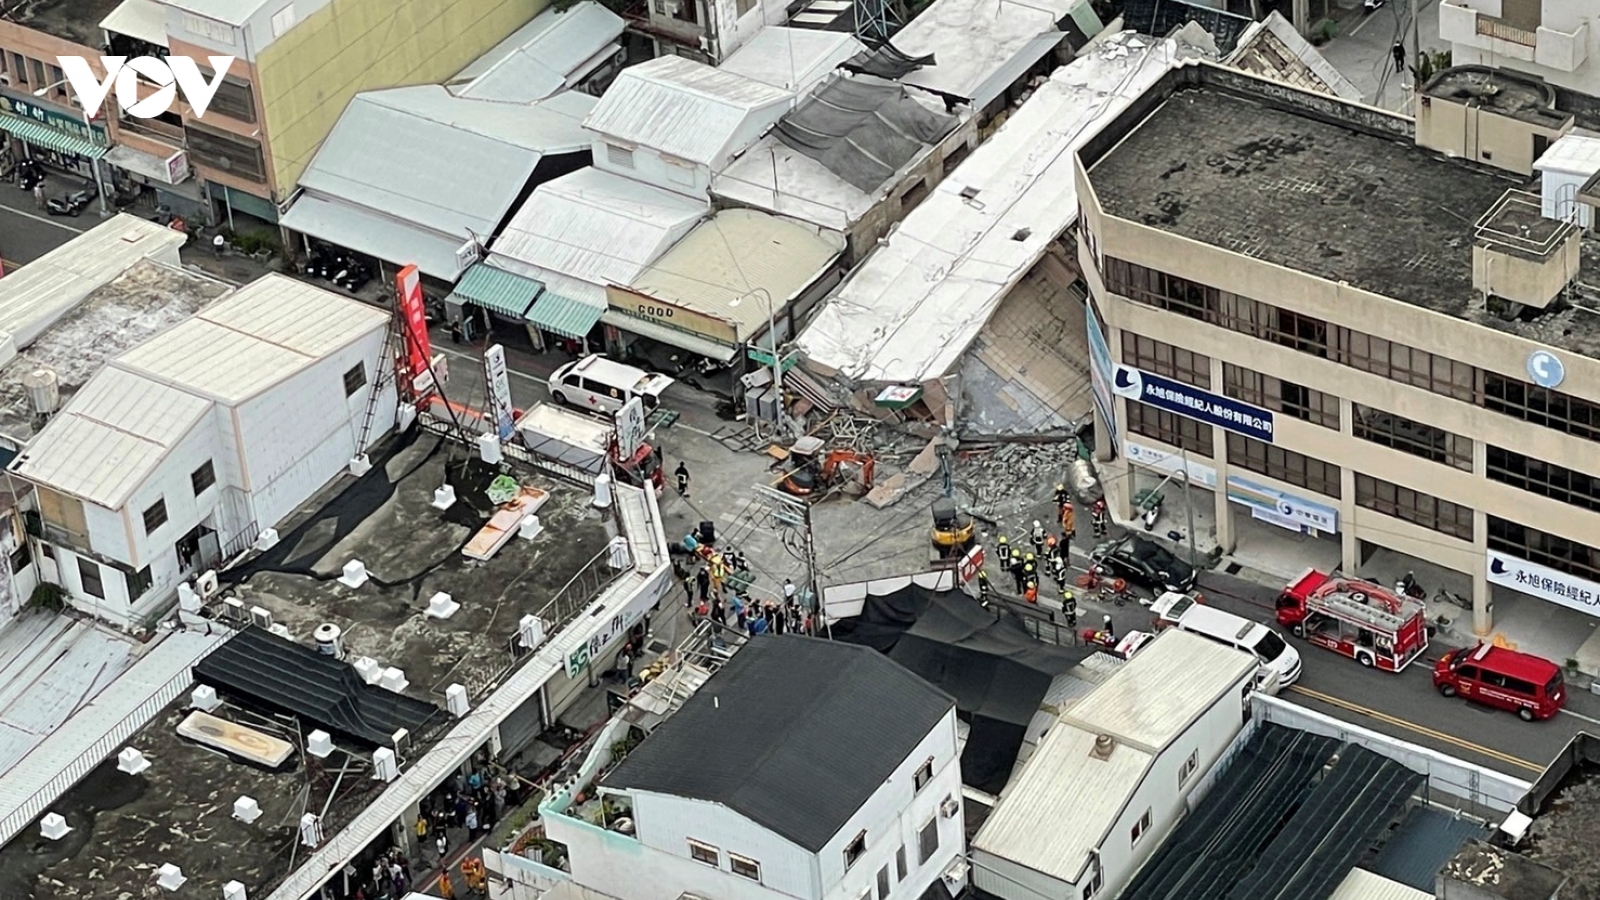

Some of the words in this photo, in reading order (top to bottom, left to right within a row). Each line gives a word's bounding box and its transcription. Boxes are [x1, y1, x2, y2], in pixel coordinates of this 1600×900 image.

[1145, 384, 1272, 433] 永旭保險經紀人股份有限公司
